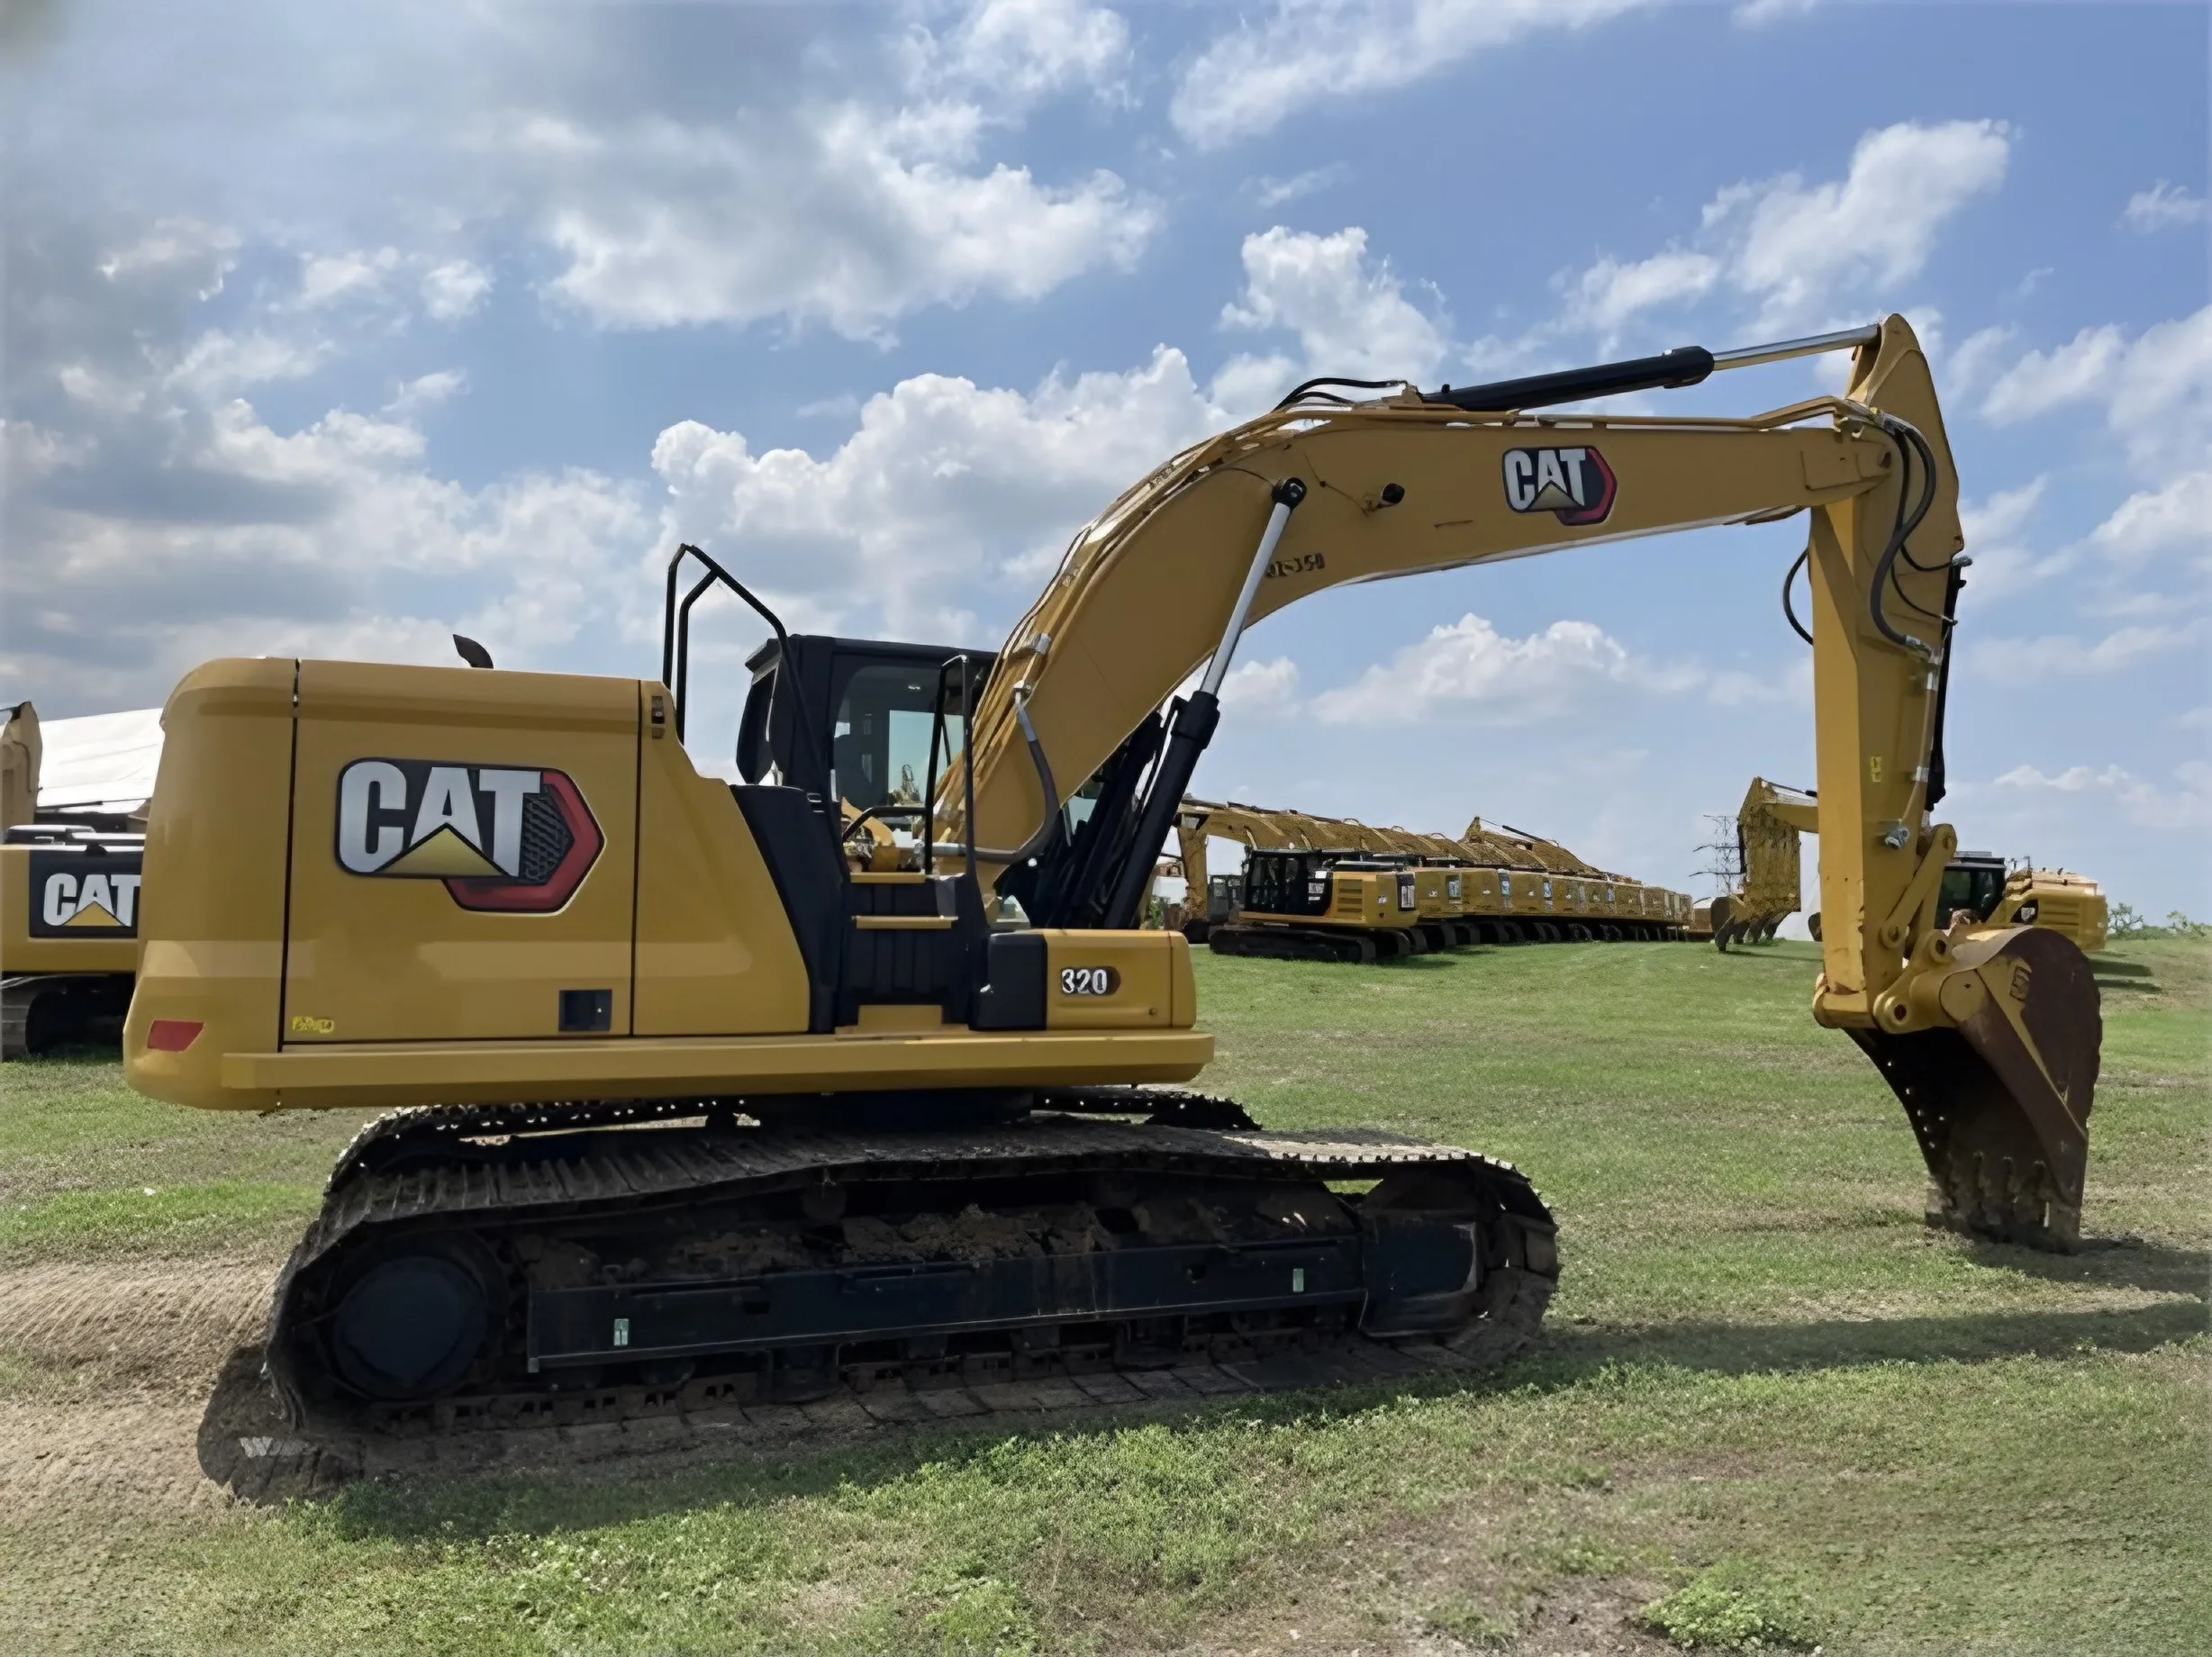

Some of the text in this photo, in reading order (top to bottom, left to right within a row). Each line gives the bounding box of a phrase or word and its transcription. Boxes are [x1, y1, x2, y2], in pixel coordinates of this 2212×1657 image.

[1503, 448, 1586, 511] CAT
[339, 760, 541, 878] CAT
[42, 873, 142, 928] CAT
[1061, 968, 1108, 995] 320
